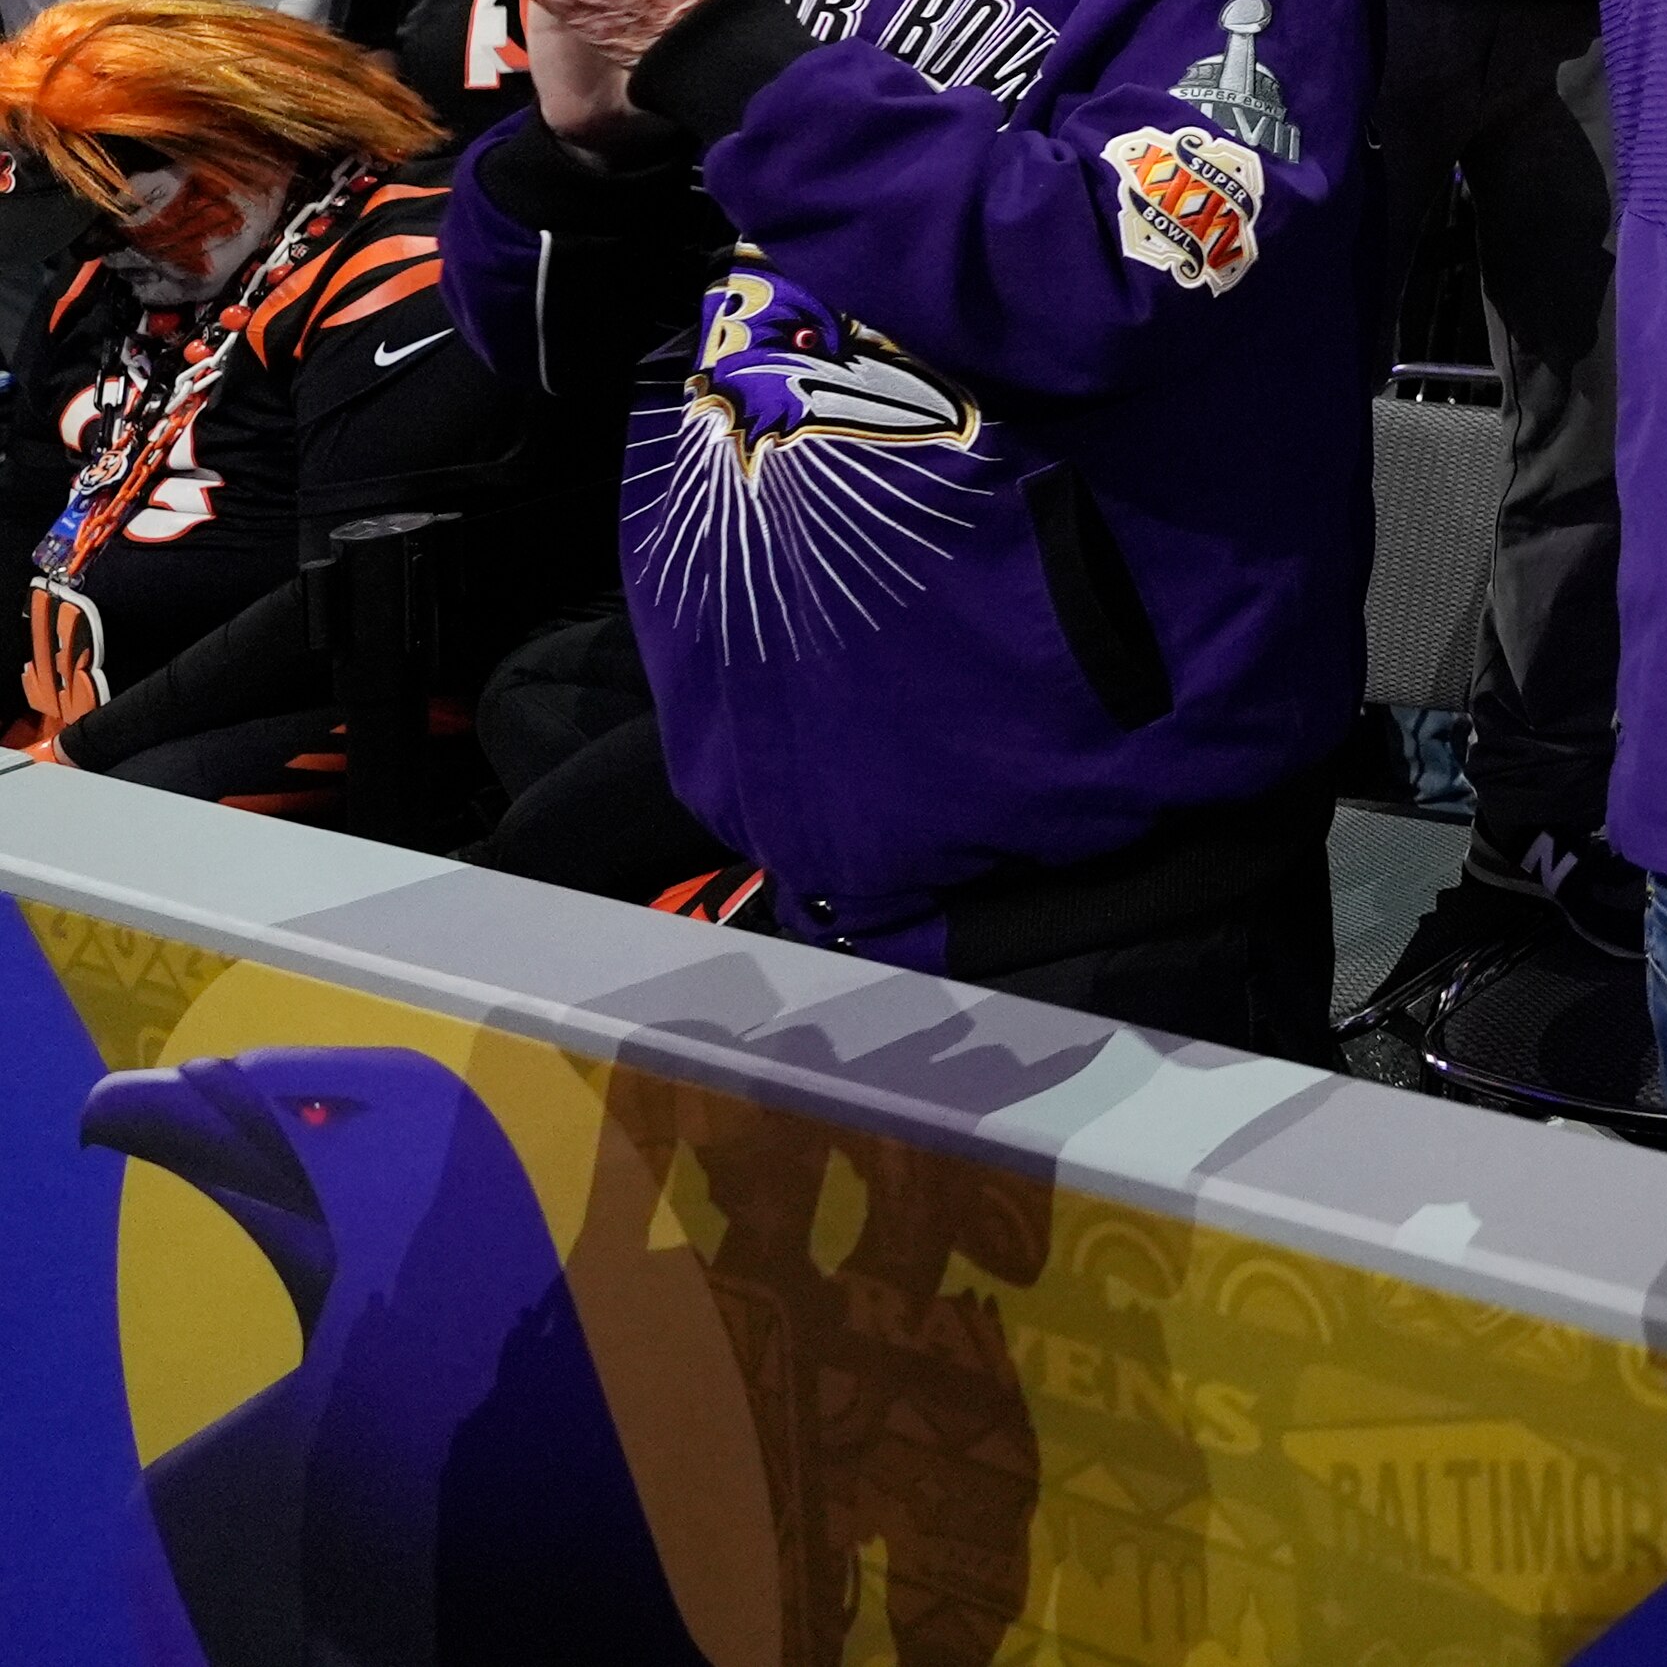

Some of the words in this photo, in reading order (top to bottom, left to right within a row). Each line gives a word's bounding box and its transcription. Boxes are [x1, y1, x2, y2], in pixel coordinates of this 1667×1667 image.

[1179, 88, 1237, 102] SUPER
[1189, 157, 1247, 203] SUPER
[1142, 205, 1192, 252] BOWL
[700, 273, 774, 370] B
[846, 1269, 1264, 1456] RAVENS
